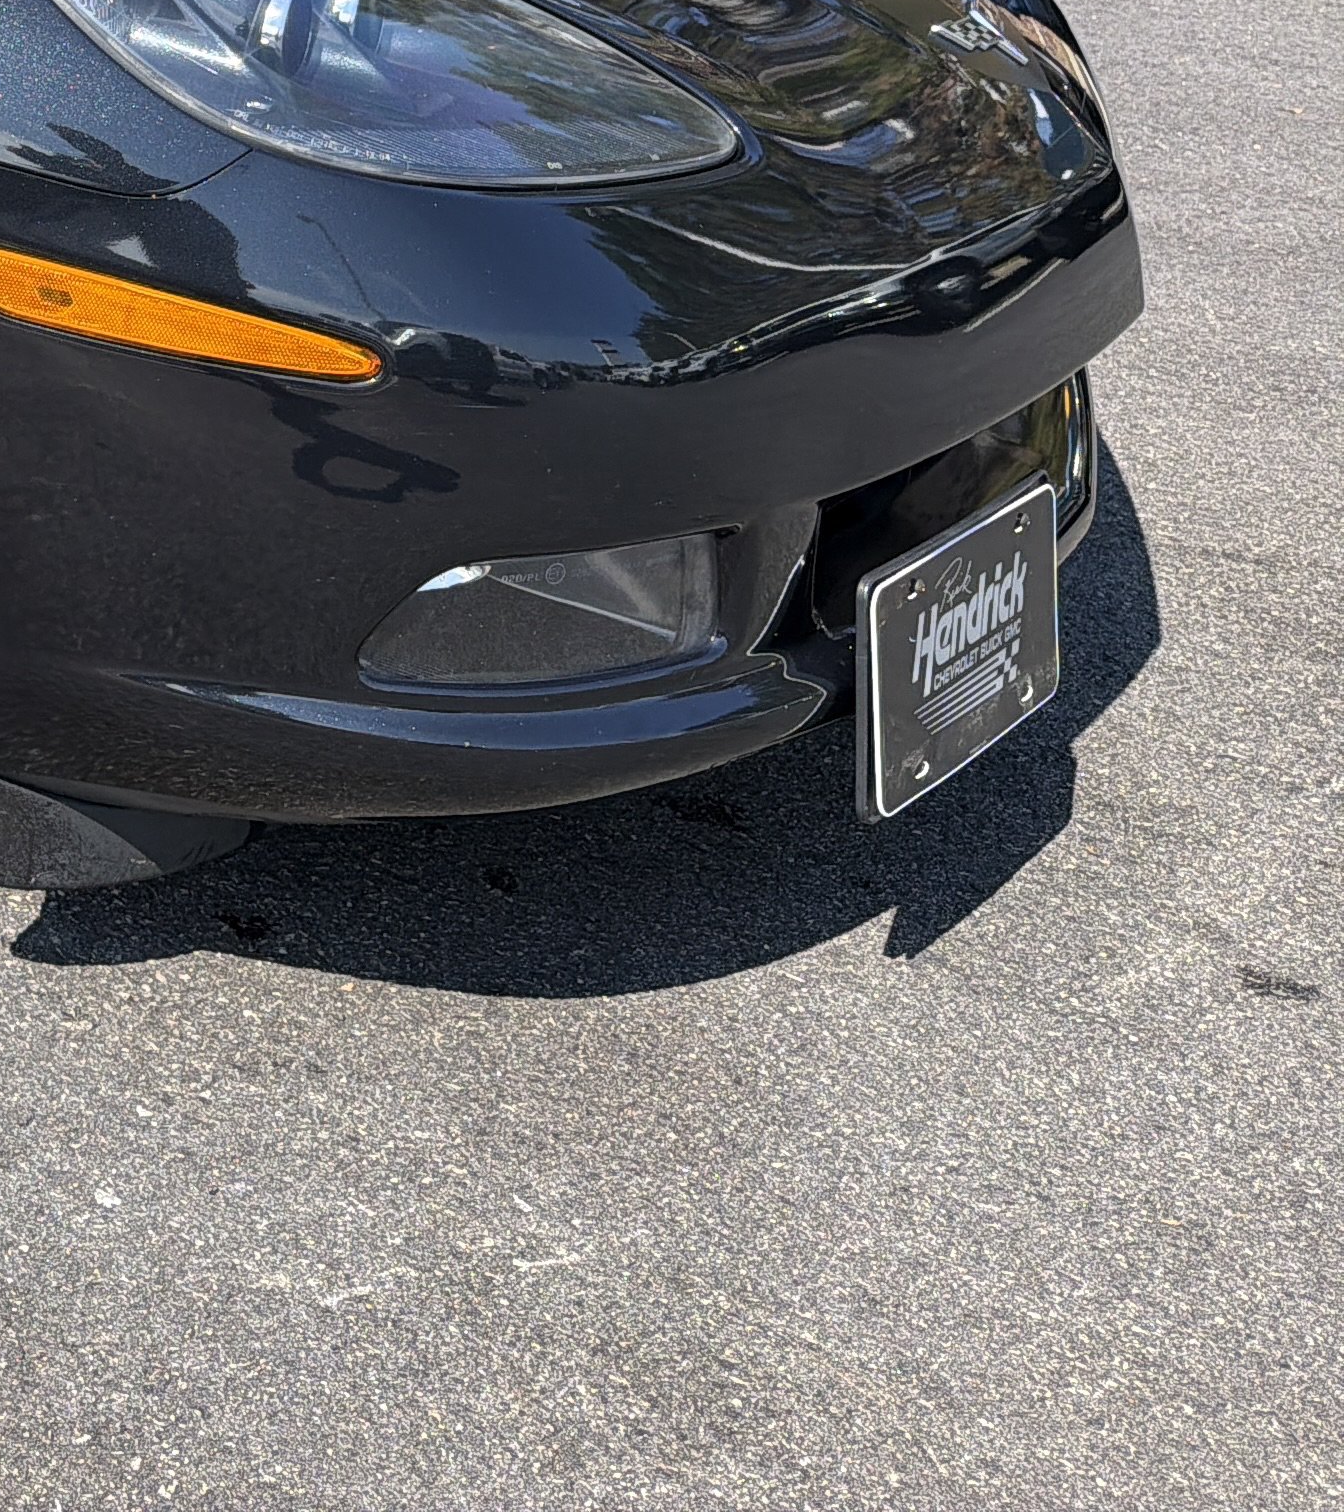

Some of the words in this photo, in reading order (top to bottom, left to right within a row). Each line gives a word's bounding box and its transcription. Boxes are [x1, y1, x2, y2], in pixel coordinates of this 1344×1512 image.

[911, 551, 1027, 698] Hendrick
[934, 646, 979, 691] CHEVROLET
[980, 632, 1004, 659] BUICK
[1005, 618, 1022, 641] GMC
